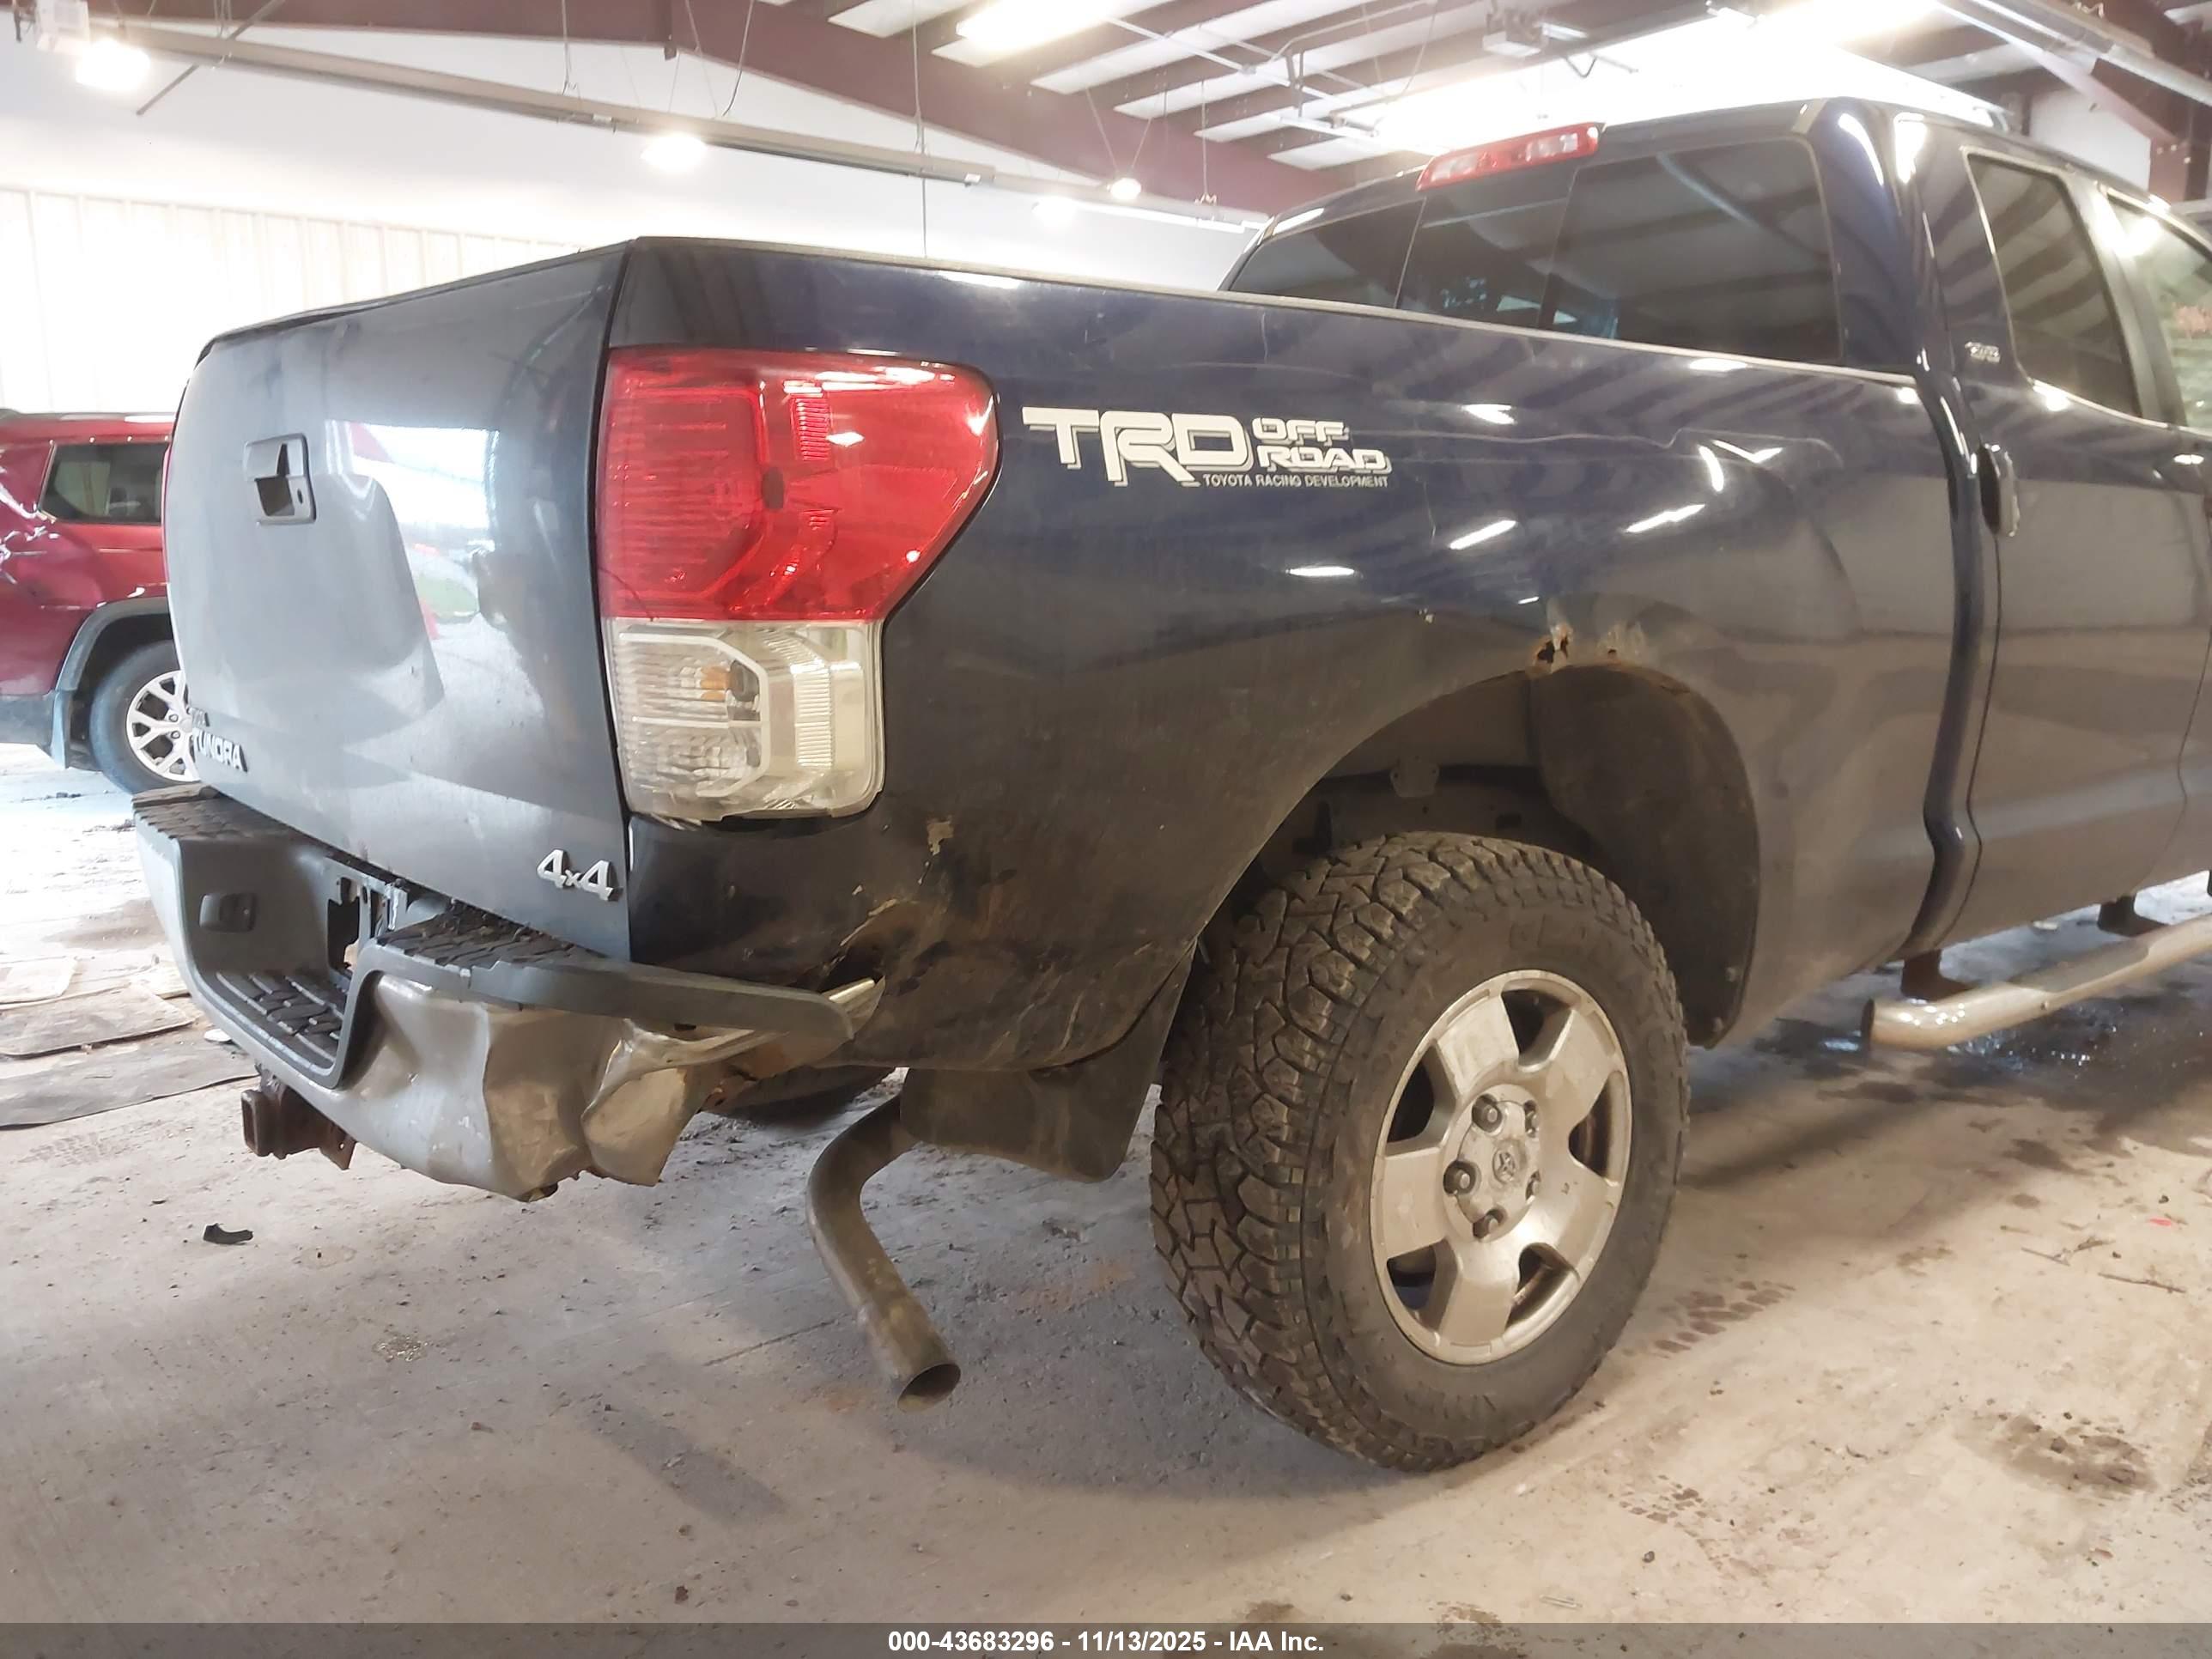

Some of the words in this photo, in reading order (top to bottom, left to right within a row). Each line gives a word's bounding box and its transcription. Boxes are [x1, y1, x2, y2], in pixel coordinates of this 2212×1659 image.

[1252, 417, 1350, 446] OFF
[1022, 406, 1254, 487] TRD
[1256, 445, 1393, 474] ROAD
[1203, 473, 1253, 488] TOYOTA
[1255, 474, 1302, 488] RACING
[1304, 474, 1389, 488] DEVELOPMENT
[191, 727, 247, 773] TUNDRA
